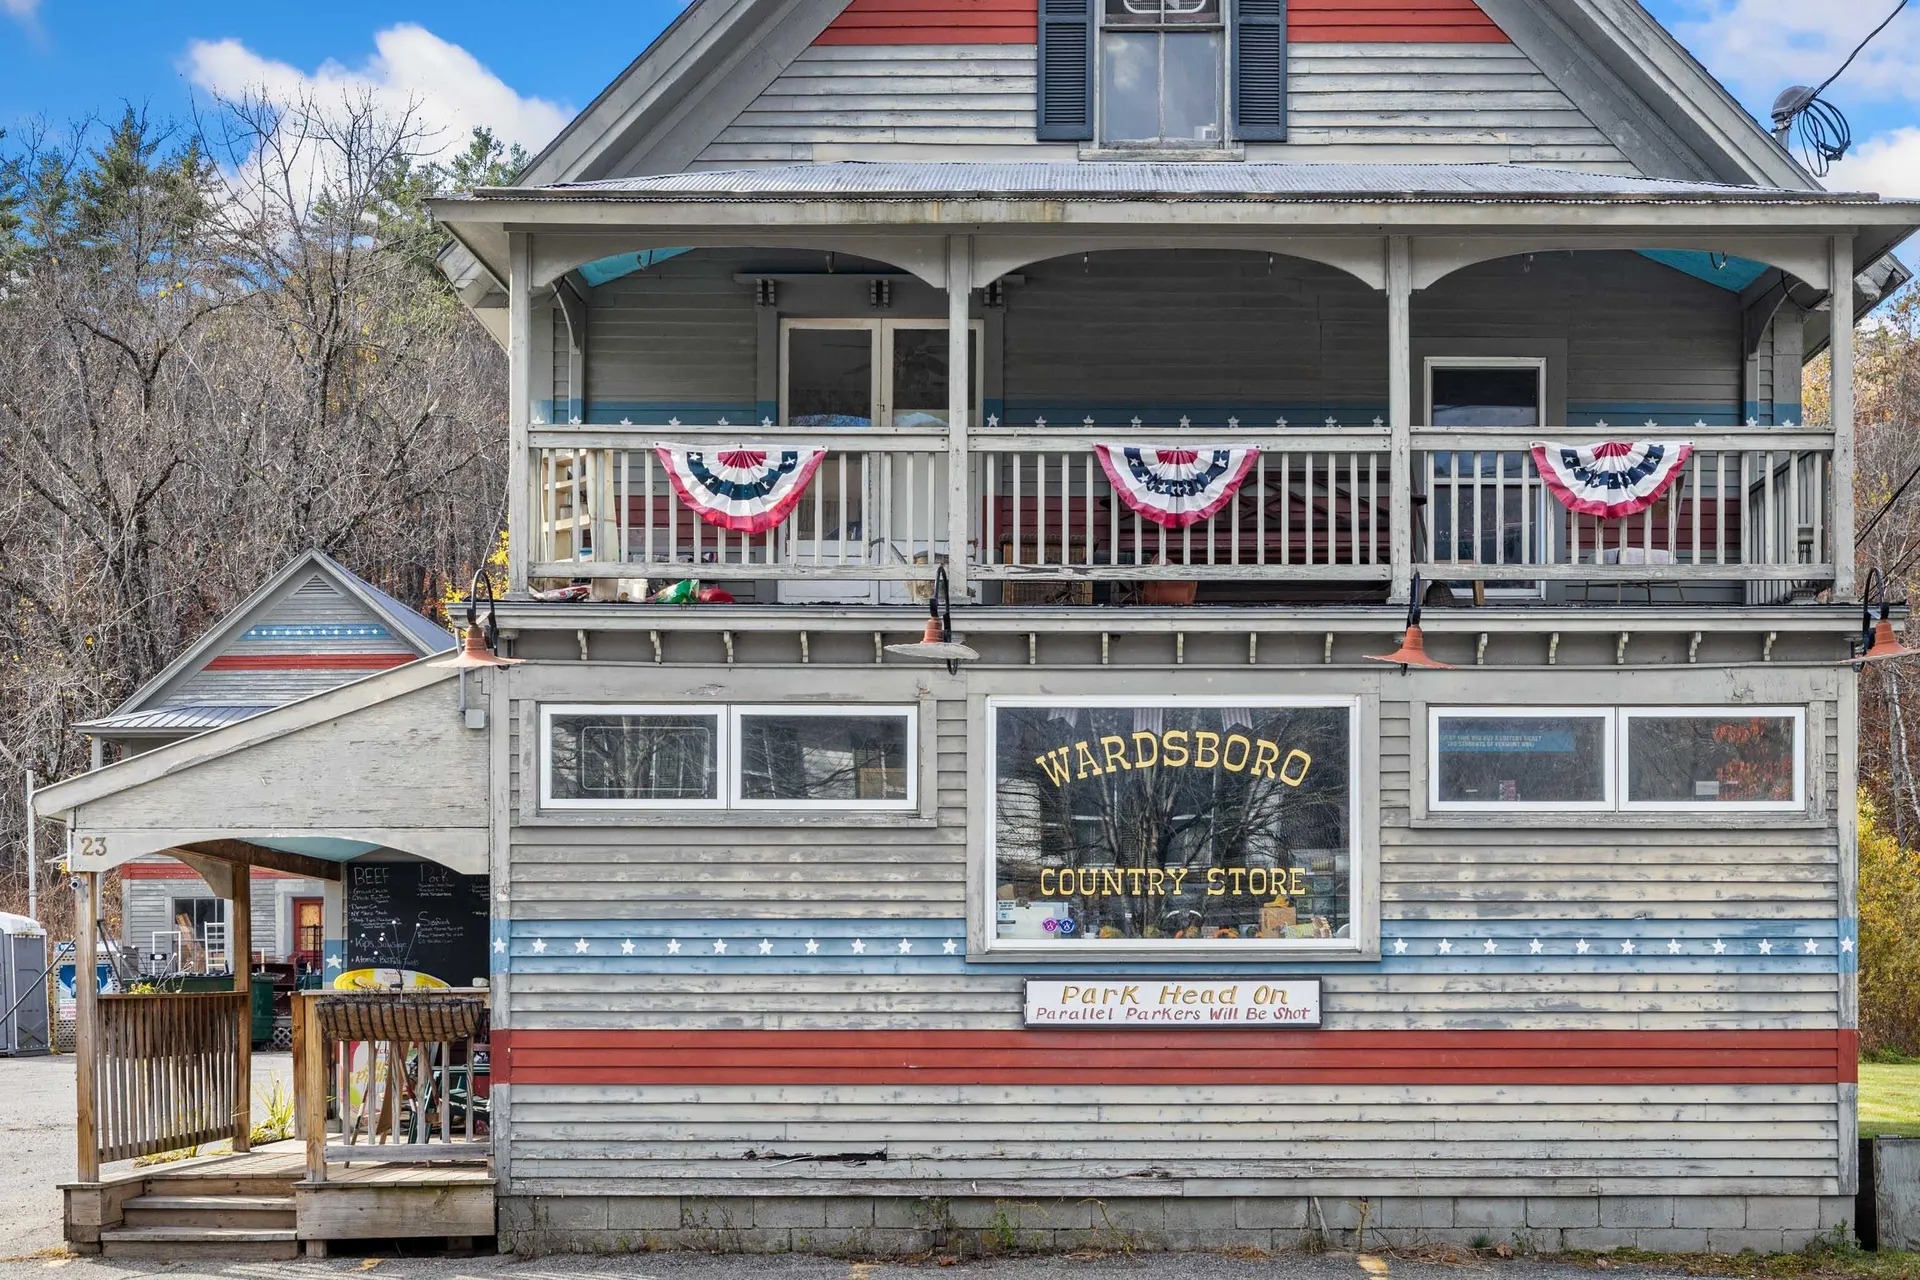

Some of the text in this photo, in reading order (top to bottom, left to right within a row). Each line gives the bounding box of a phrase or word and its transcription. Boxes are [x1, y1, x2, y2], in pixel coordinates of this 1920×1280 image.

[1036, 730, 1312, 787] WARDSBORO
[81, 836, 107, 856] 23
[354, 866, 390, 886] BEEF
[1041, 867, 1307, 896] COUNTRY STORE
[1159, 985, 1238, 1005] Head
[1253, 985, 1288, 1005] On
[1036, 1007, 1113, 1020] Parallel
[1209, 1007, 1239, 1020] Will
[1246, 1007, 1268, 1020] Be
[1273, 1007, 1312, 1020] Shot
